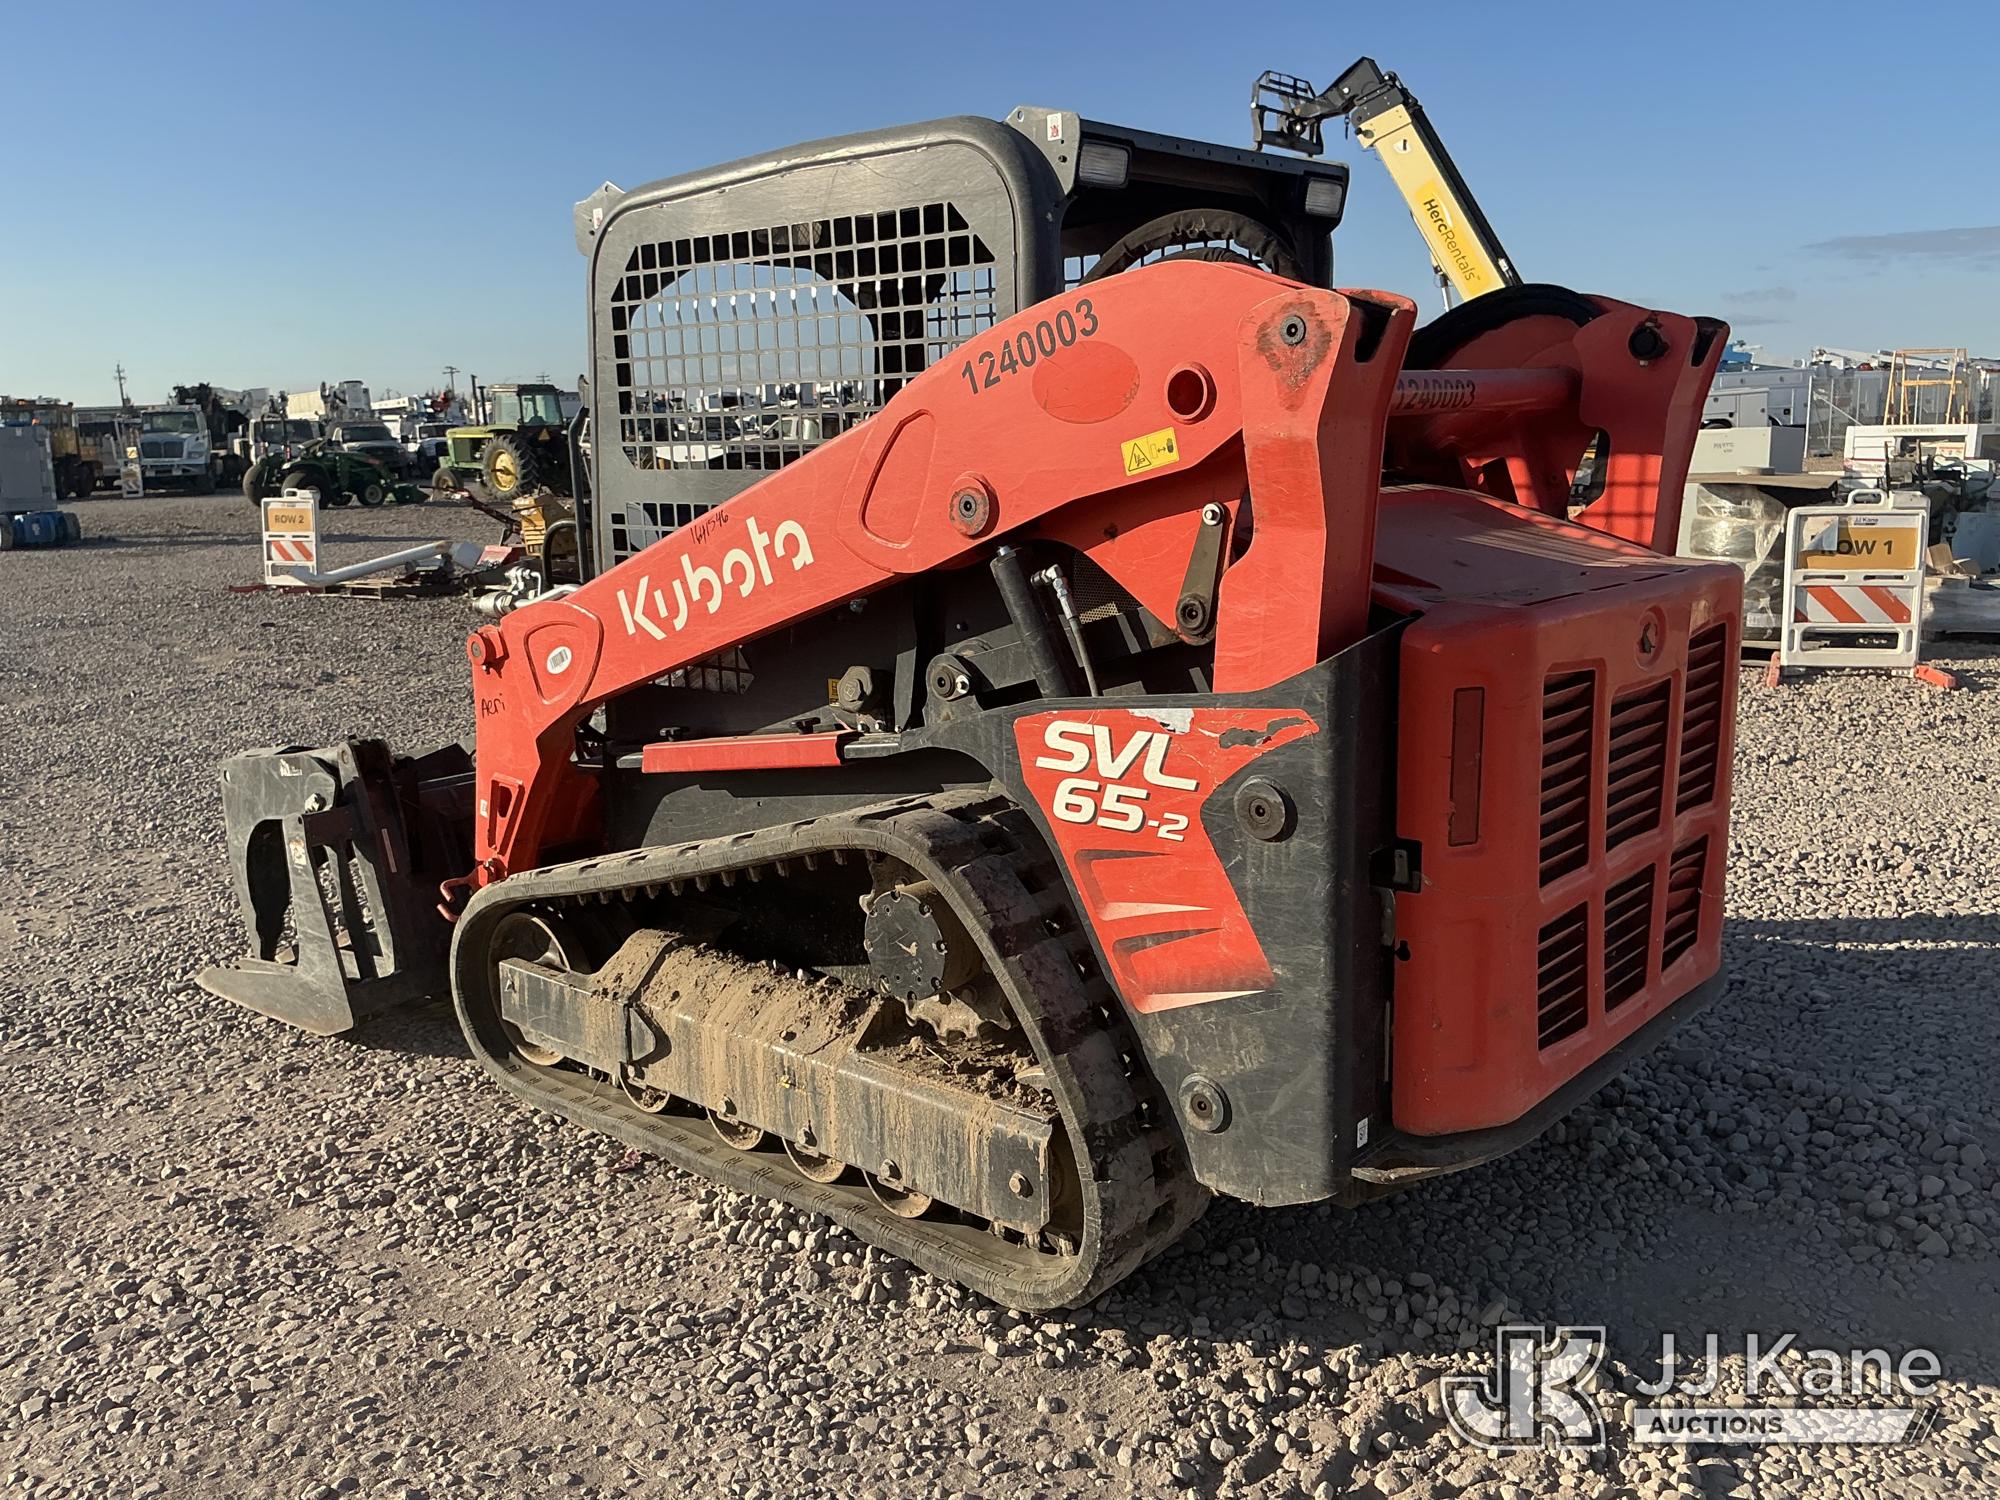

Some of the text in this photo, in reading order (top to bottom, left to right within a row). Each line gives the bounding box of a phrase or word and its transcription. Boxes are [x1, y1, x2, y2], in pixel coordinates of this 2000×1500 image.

[1423, 198, 1477, 281] HercRentals
[961, 298, 1099, 394] 1240003
[274, 514, 305, 524] ROW 2
[1821, 540, 1893, 555] OW 1
[617, 516, 815, 641] Kubota
[1035, 720, 1200, 791] SVL
[1052, 778, 1190, 842] 65-2
